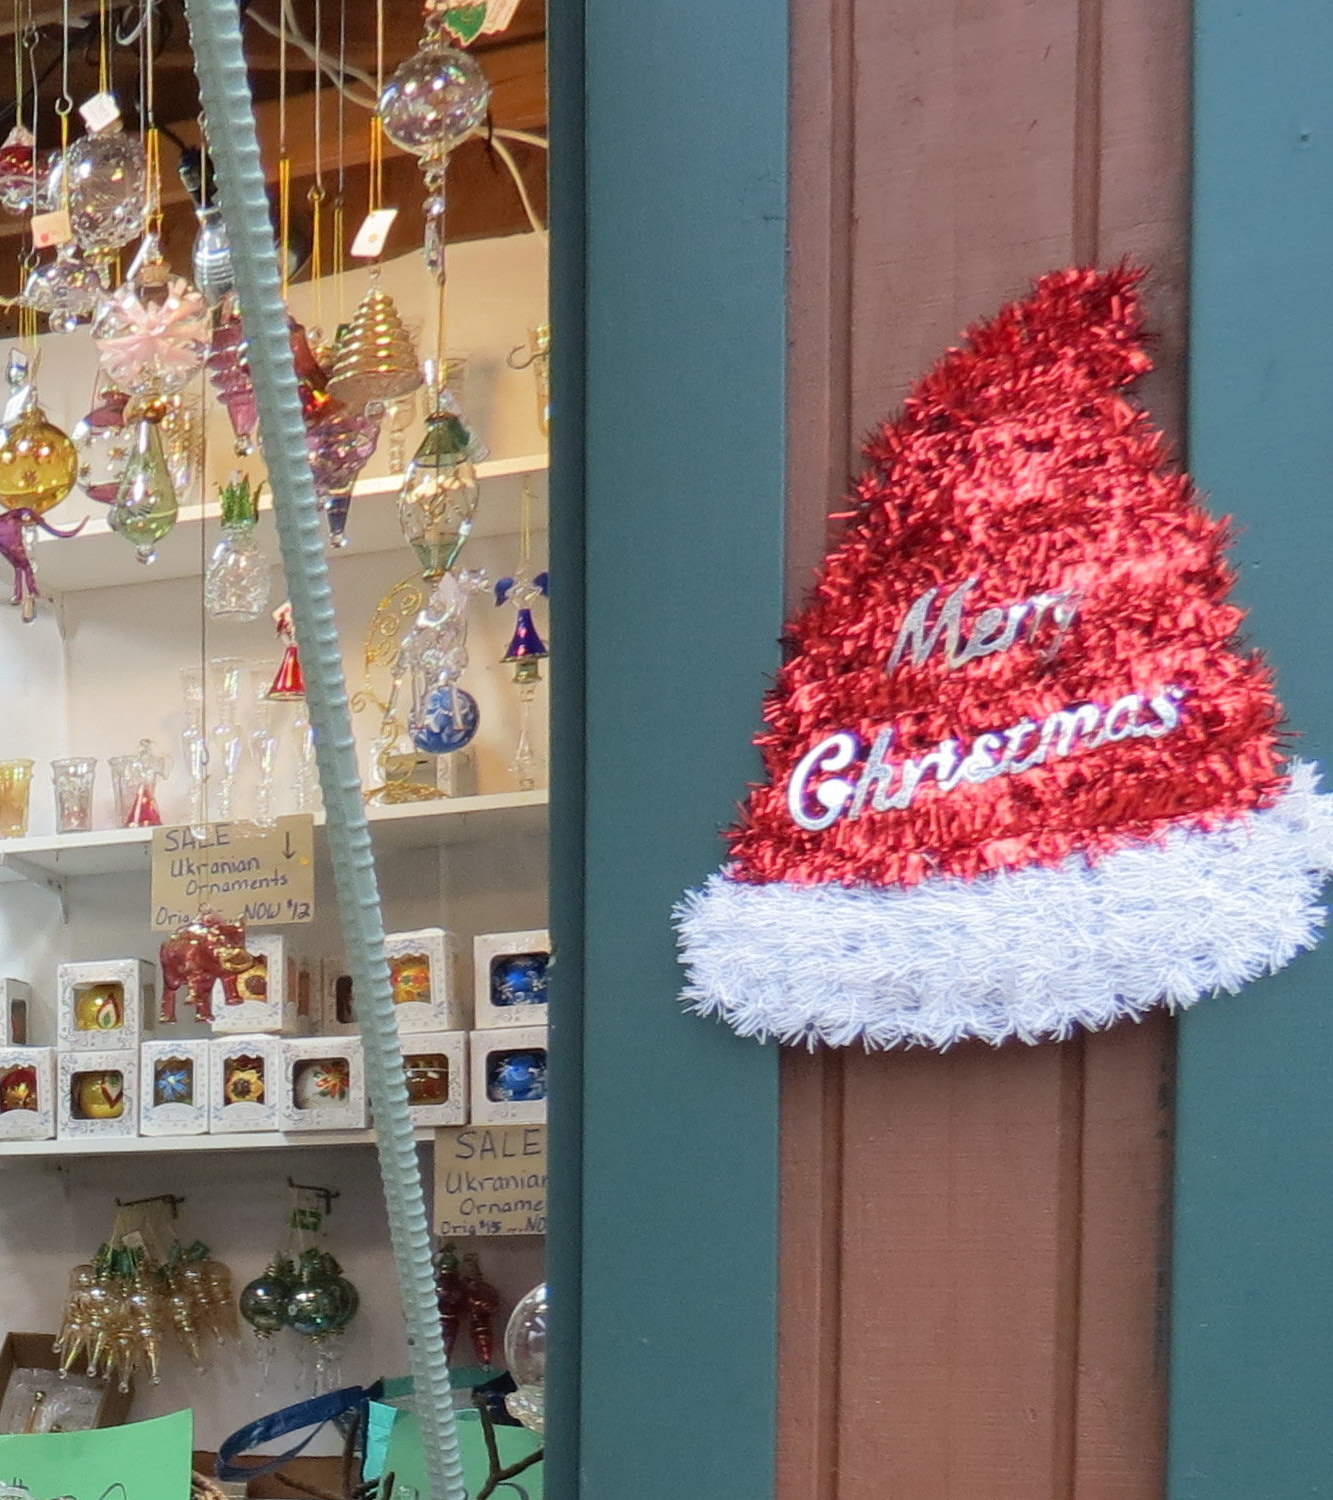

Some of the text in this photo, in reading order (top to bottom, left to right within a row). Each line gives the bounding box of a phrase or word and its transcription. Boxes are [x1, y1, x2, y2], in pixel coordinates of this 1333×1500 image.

[886, 577, 1084, 674] Merry
[788, 684, 1189, 832] Christmas
[164, 824, 231, 852] SALE
[171, 856, 260, 878] Ukranian
[186, 868, 288, 896] Ornaments
[244, 902, 281, 919] NOW
[286, 899, 311, 919] $12
[455, 1128, 542, 1160] SALE
